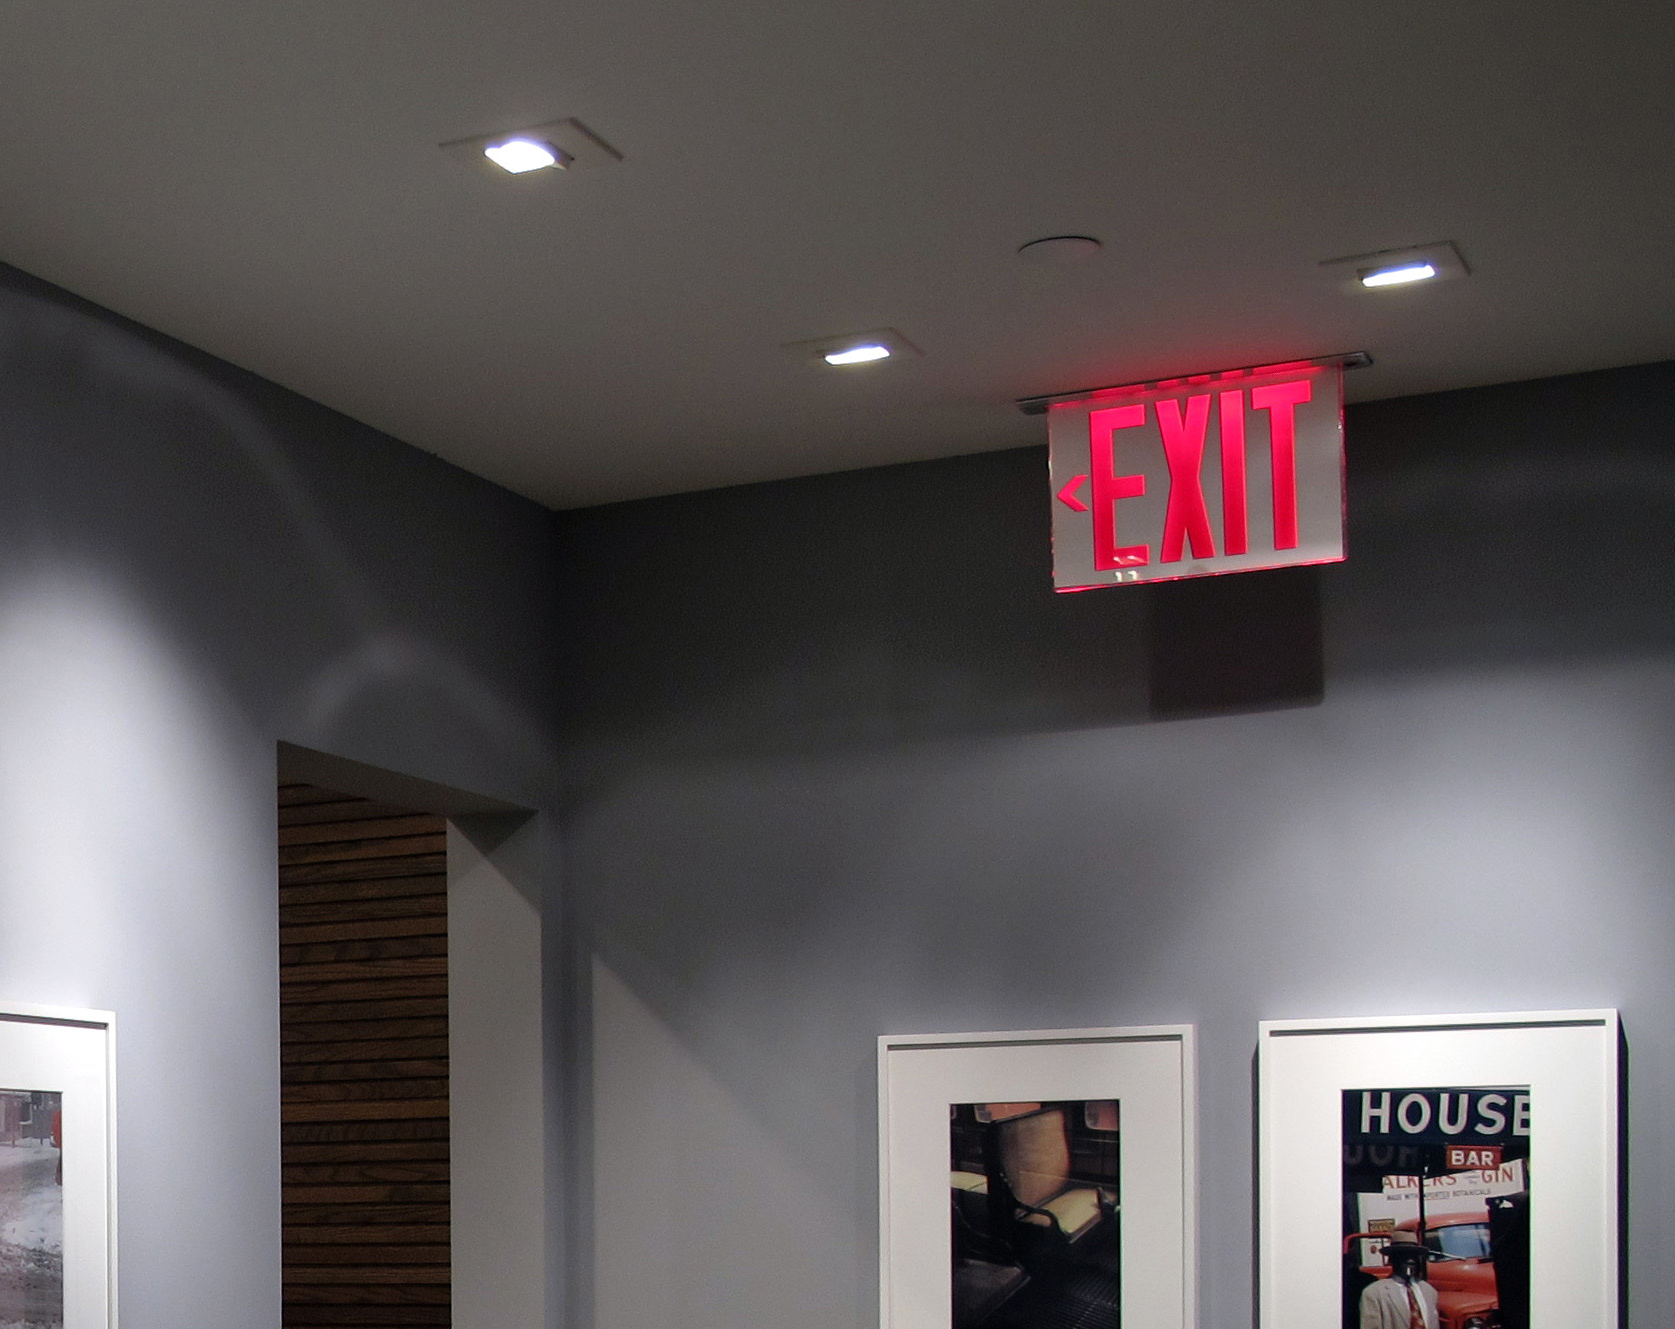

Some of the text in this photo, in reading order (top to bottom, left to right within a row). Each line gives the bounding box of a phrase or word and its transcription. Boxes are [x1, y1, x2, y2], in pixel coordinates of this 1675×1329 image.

[1089, 380, 1312, 571] EXIT
[1360, 1091, 1530, 1136] HOUSE
[1450, 1149, 1494, 1167] BAR
[1383, 1174, 1457, 1189] ALKRS
[1481, 1166, 1514, 1184] GIN
